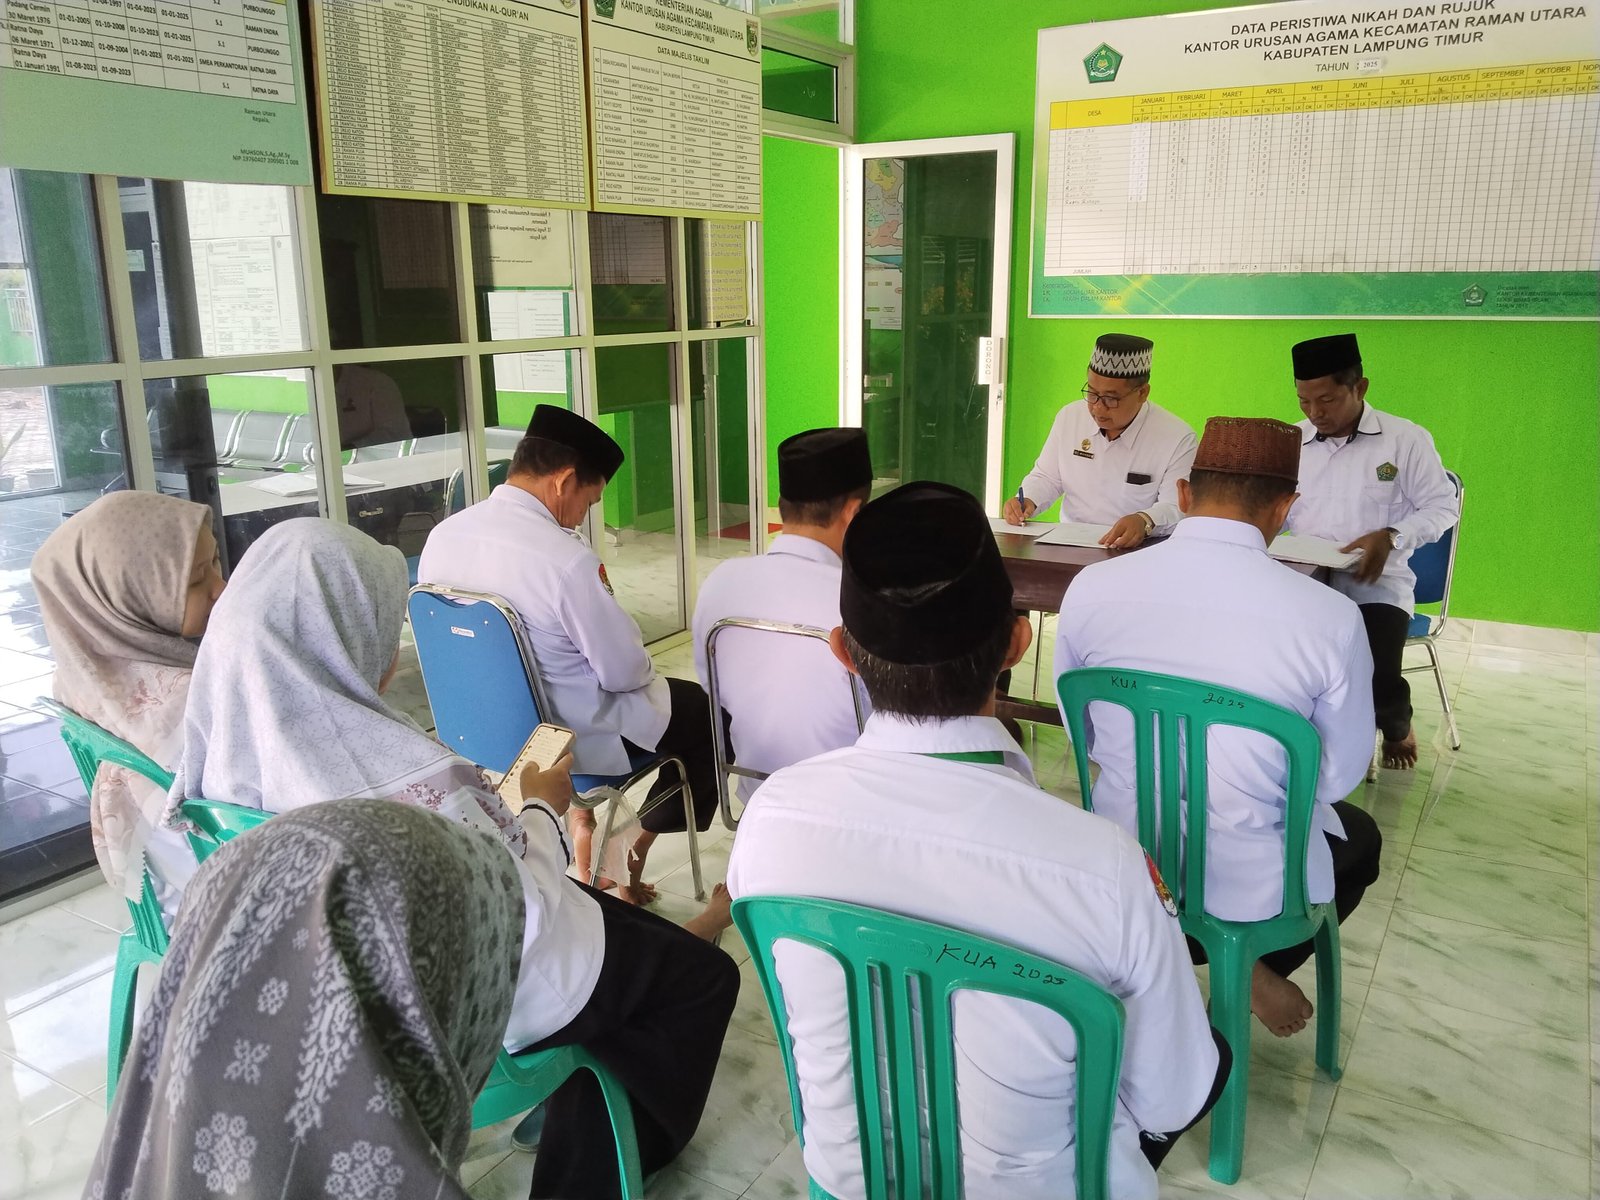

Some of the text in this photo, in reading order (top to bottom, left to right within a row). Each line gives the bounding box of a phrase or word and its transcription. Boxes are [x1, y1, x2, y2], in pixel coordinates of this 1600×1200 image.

[17, 12, 36, 22] Maret
[161, 9, 189, 20] 01-01-2025
[490, 5, 529, 21] AL-QUR'AN
[694, 8, 713, 20] AGAMA
[1231, 0, 1495, 36] DATA PERISTIWA NIKAH DAN RUJUK
[620, 1, 744, 41] KANTOR URUSAN AGAMA KECAMATAN RAMAN UTARA
[655, 22, 715, 44] KABUPATEN LAMPUNG TIMUR
[1184, 6, 1587, 54] KANTOR URUSAN AGAMA KECAMATAN RAMAN UTARA
[20, 35, 39, 46] Maret
[164, 31, 192, 42] 01-01-2025
[1263, 31, 1484, 61] KABUPATEN LAMPUNG TIMUR
[167, 53, 194, 64] 01-01-2025
[657, 46, 710, 65] DATA MAJELIS TAKLIM
[214, 60, 248, 71] PERKANTORAN
[1315, 62, 1349, 72] TAHUN
[1535, 65, 1571, 74] OKTOBER
[1436, 73, 1470, 82] AGUSTUS
[1481, 69, 1524, 78] SEPTEMBER
[1141, 96, 1165, 104] JANUARI
[1176, 93, 1205, 101] FEBRUARI
[1111, 675, 1246, 709] KUA 2025
[936, 943, 1067, 985] KUA 2025
